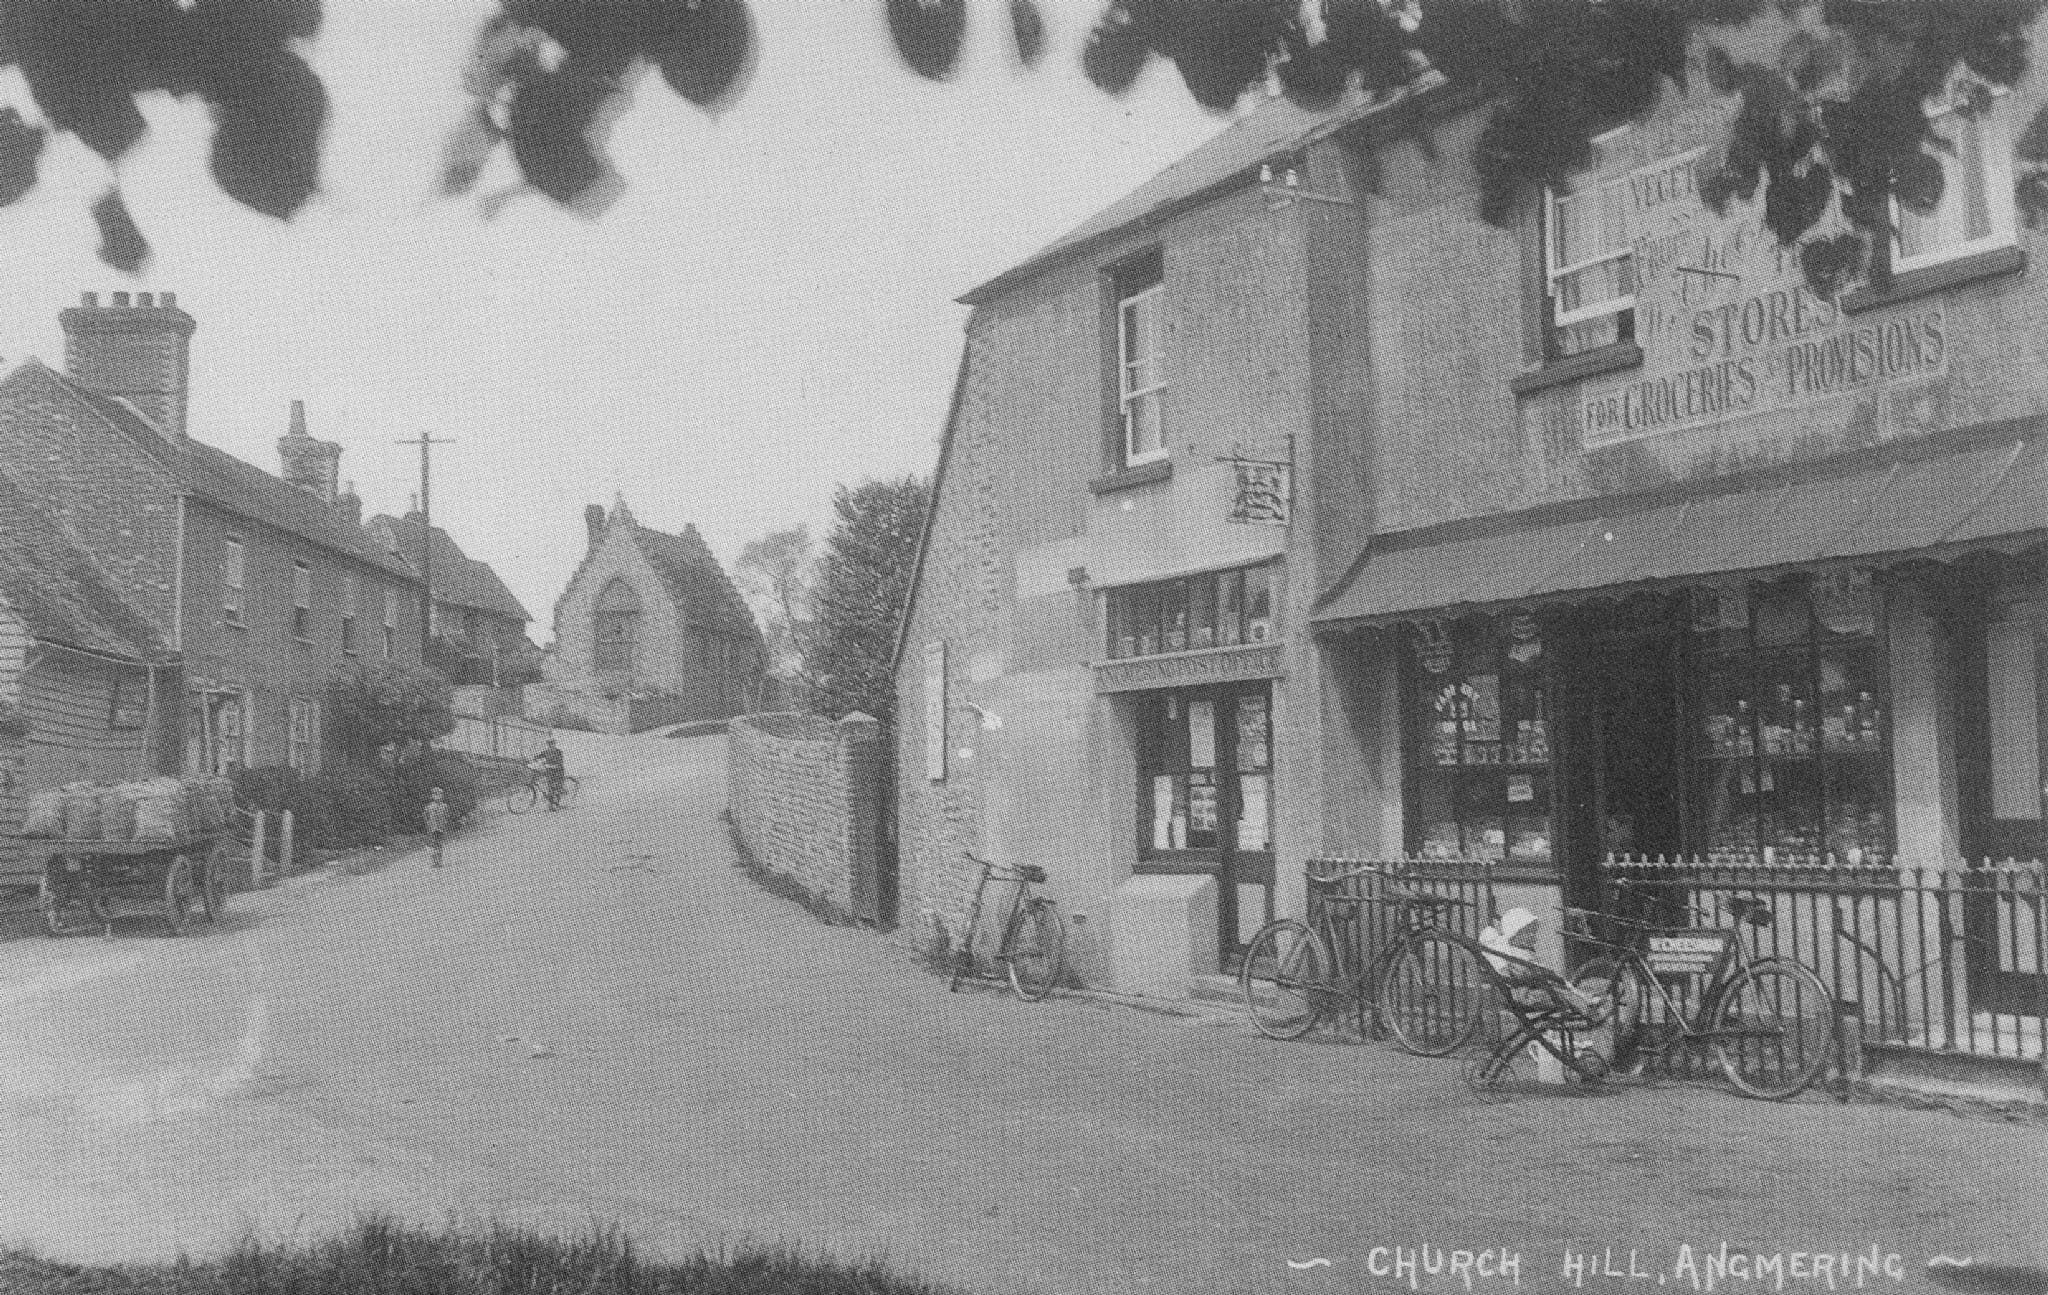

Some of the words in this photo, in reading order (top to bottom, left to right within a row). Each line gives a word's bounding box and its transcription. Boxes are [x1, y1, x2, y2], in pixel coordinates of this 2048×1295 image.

[1628, 166, 1695, 211] VEGET
[1691, 285, 1838, 362] STORES
[1586, 396, 1619, 431] FOR
[1622, 356, 1757, 430] GROCERIES
[1786, 310, 1945, 395] PROVISIONS
